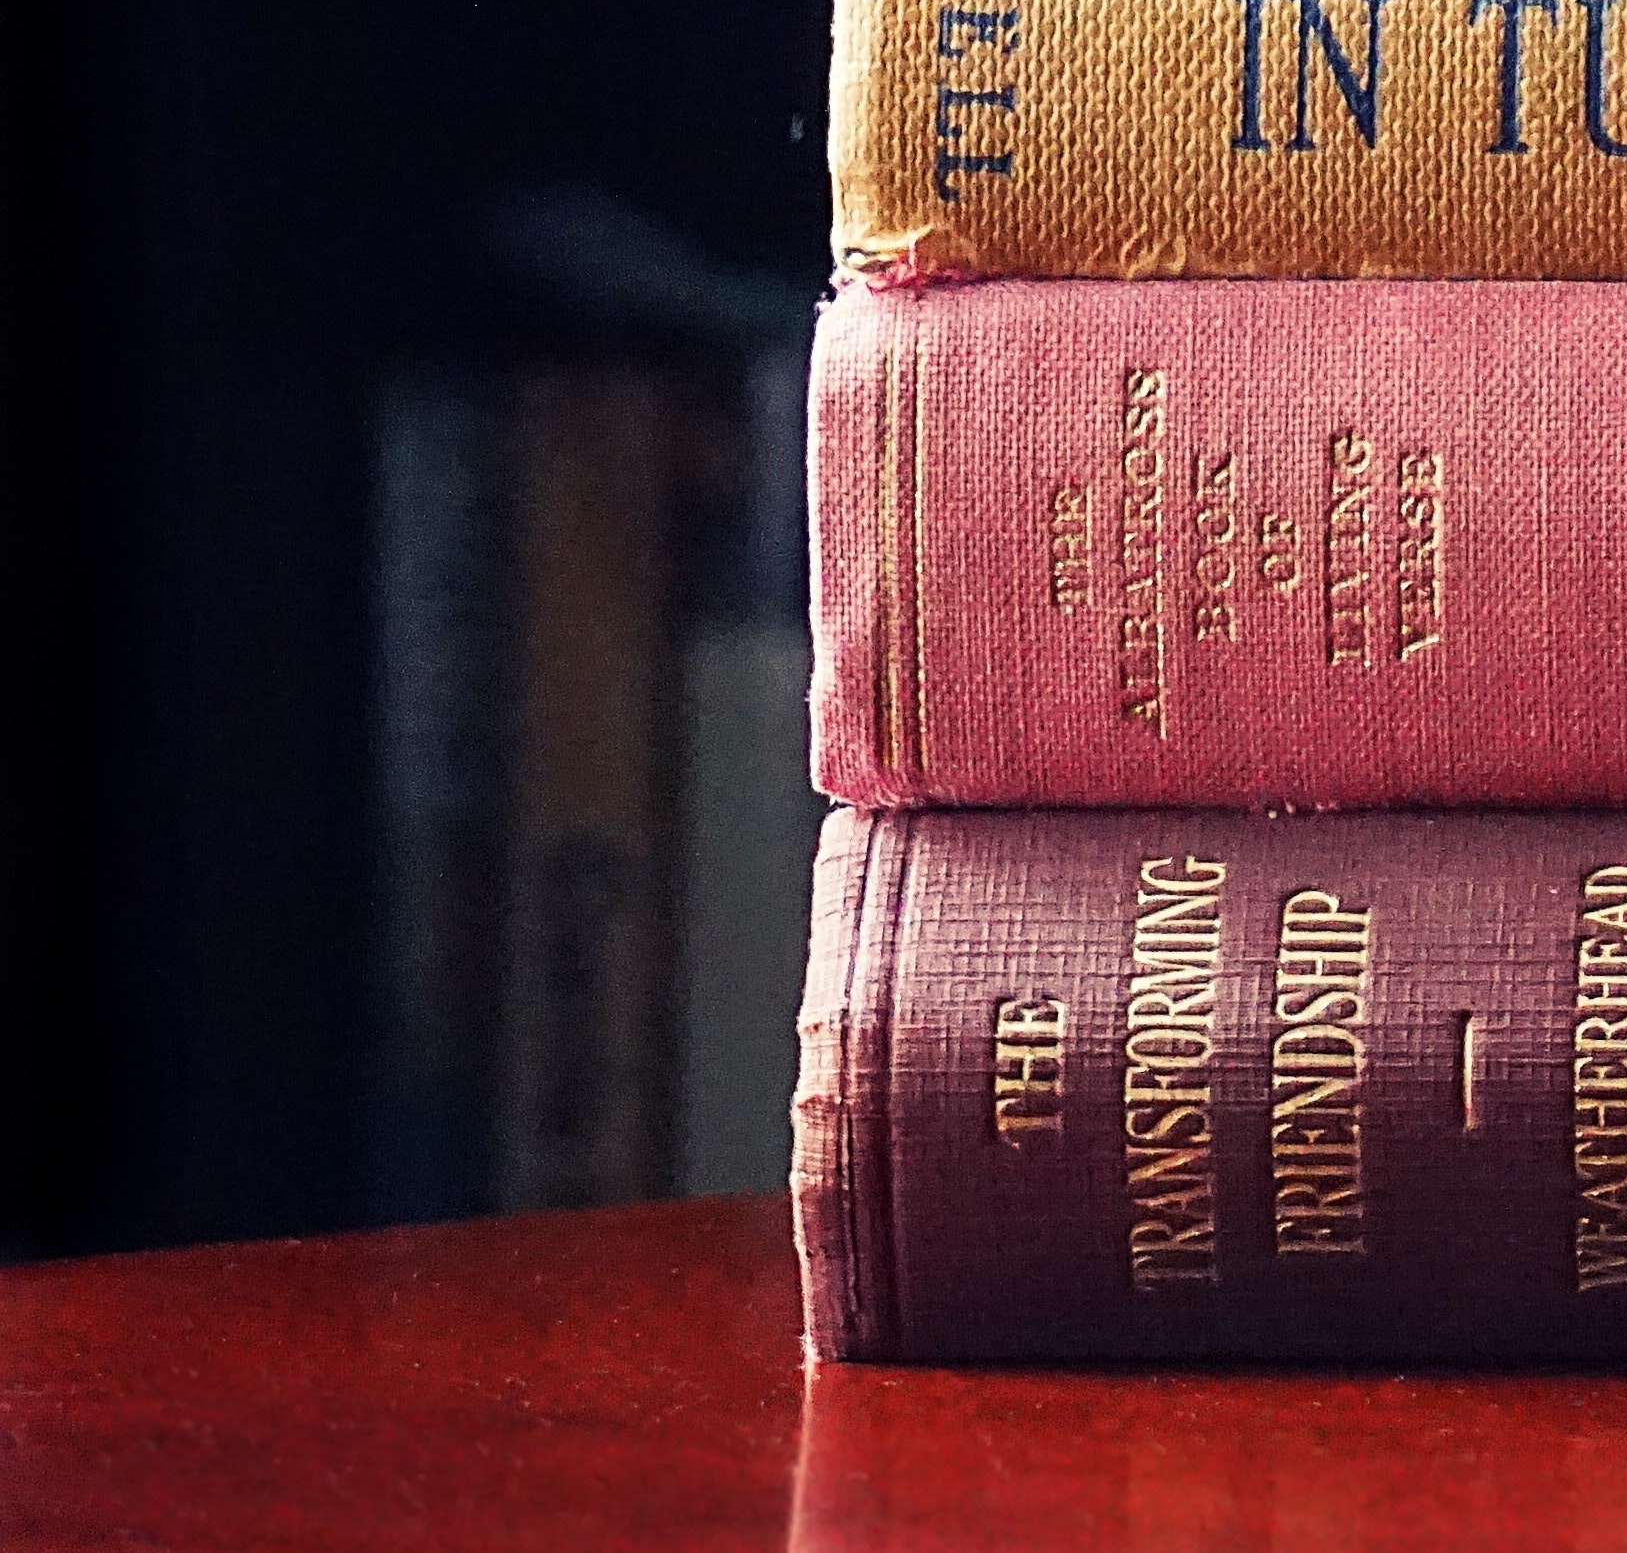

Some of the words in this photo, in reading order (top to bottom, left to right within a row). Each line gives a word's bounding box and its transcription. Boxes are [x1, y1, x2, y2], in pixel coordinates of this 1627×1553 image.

[1051, 484, 1092, 614] THE
[1120, 368, 1168, 739] ALBATROSS
[1194, 451, 1236, 642] BOOK
[1259, 512, 1299, 592] OF
[1328, 431, 1372, 668] LIVING
[1399, 451, 1444, 661] VERSE
[995, 994, 1065, 1149] THE
[1125, 855, 1228, 1291] TRANSFORMING
[1272, 888, 1373, 1257] FRIENDSHIP
